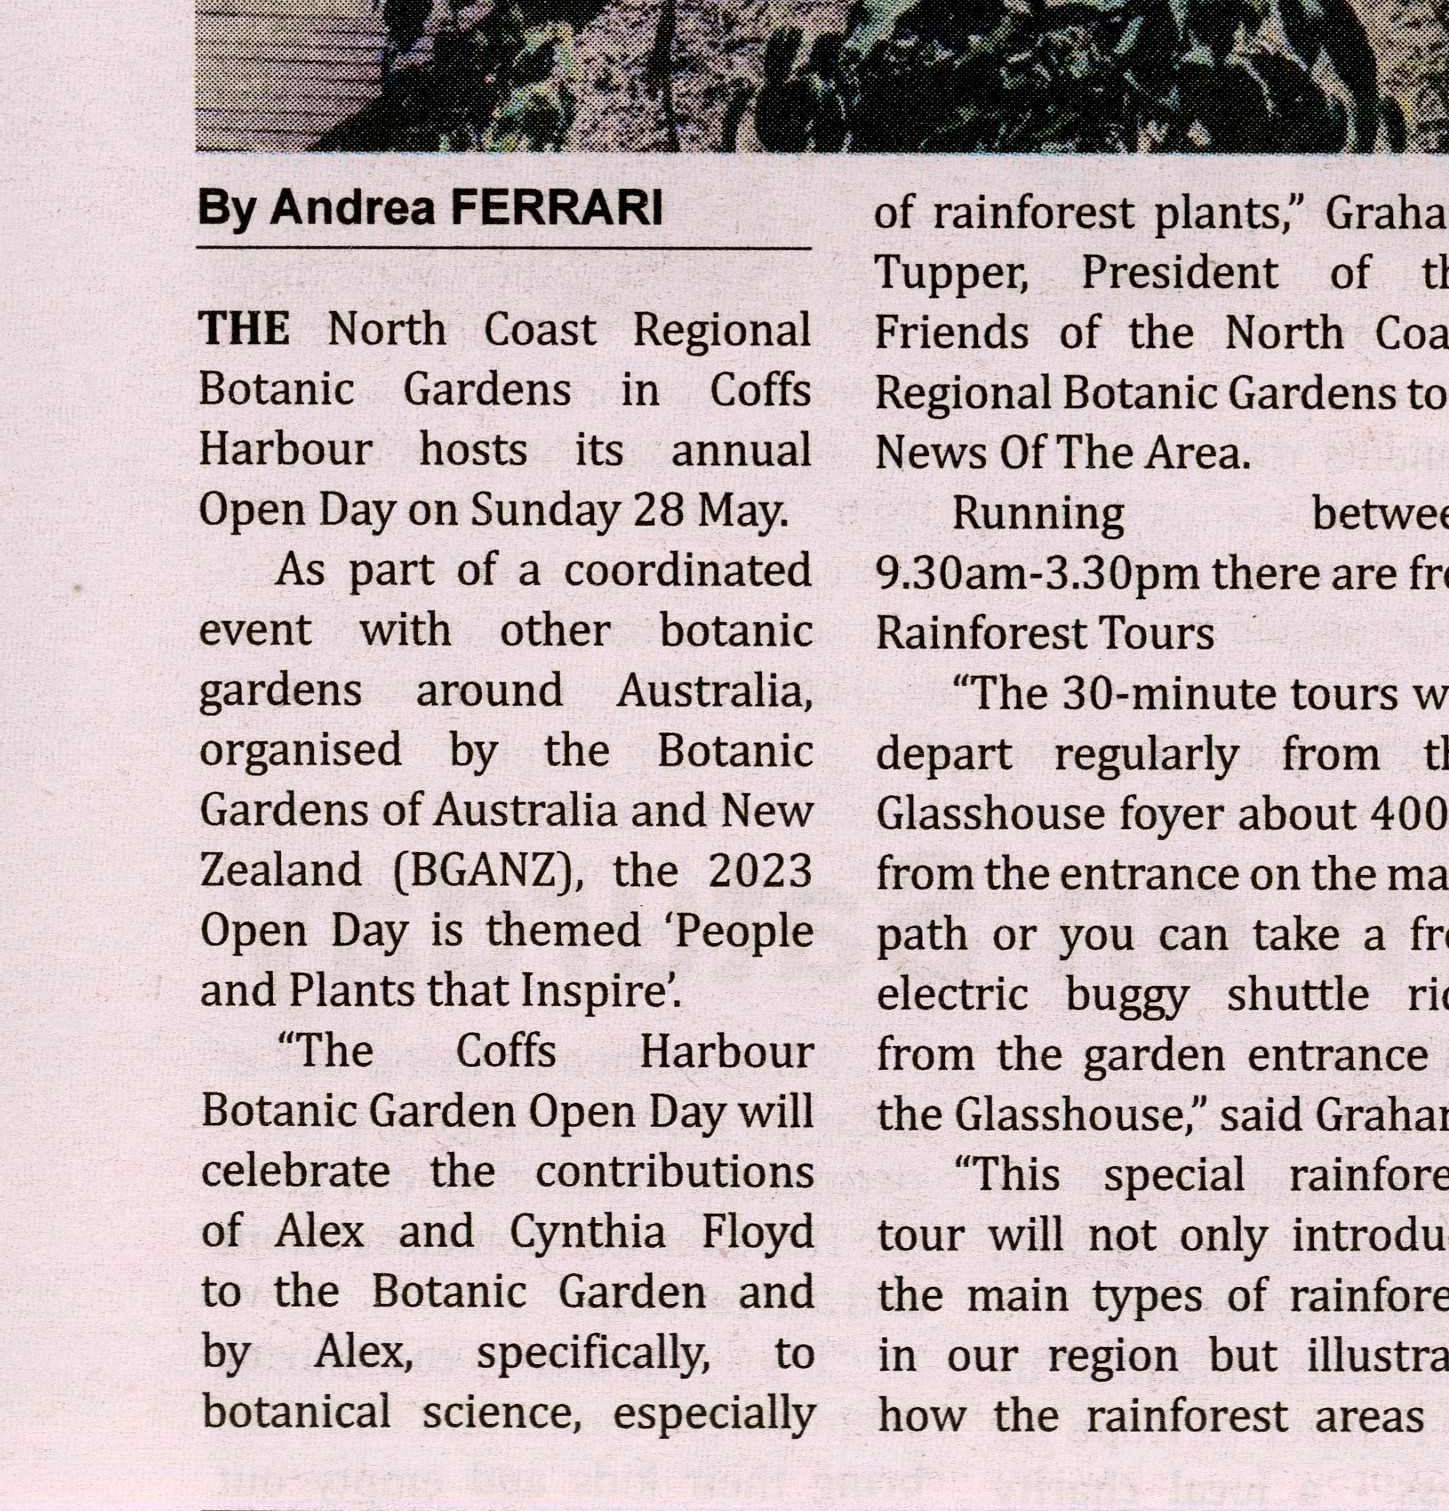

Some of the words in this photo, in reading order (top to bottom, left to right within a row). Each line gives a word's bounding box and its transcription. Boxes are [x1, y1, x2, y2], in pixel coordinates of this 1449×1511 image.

[198, 187, 258, 235] By
[269, 187, 436, 226] Andrea
[452, 187, 663, 226] FERRARI
[873, 253, 1028, 299] Tupper,
[1083, 252, 1279, 290] President
[1330, 253, 1374, 290] of
[197, 309, 290, 345] THE
[329, 309, 446, 346] North
[484, 310, 597, 346] Coast
[634, 310, 811, 357] Regional
[875, 554, 1200, 600] 9.30am-3.30pm
[1212, 553, 1321, 591] there
[1332, 564, 1397, 591] are
[199, 669, 362, 717] gardens
[417, 670, 563, 707] around
[616, 670, 812, 713] Australia,
[877, 793, 1105, 831] Glasshouse
[1121, 793, 1225, 841] foyer
[1238, 794, 1357, 831] about
[200, 850, 362, 887] Zealand
[394, 850, 584, 897] (BGANZ),
[613, 851, 678, 888] the
[709, 852, 812, 888] 2023
[202, 1331, 252, 1379] by
[314, 1331, 413, 1373] Alex,
[477, 1332, 710, 1380] specifically,
[775, 1338, 815, 1370] to
